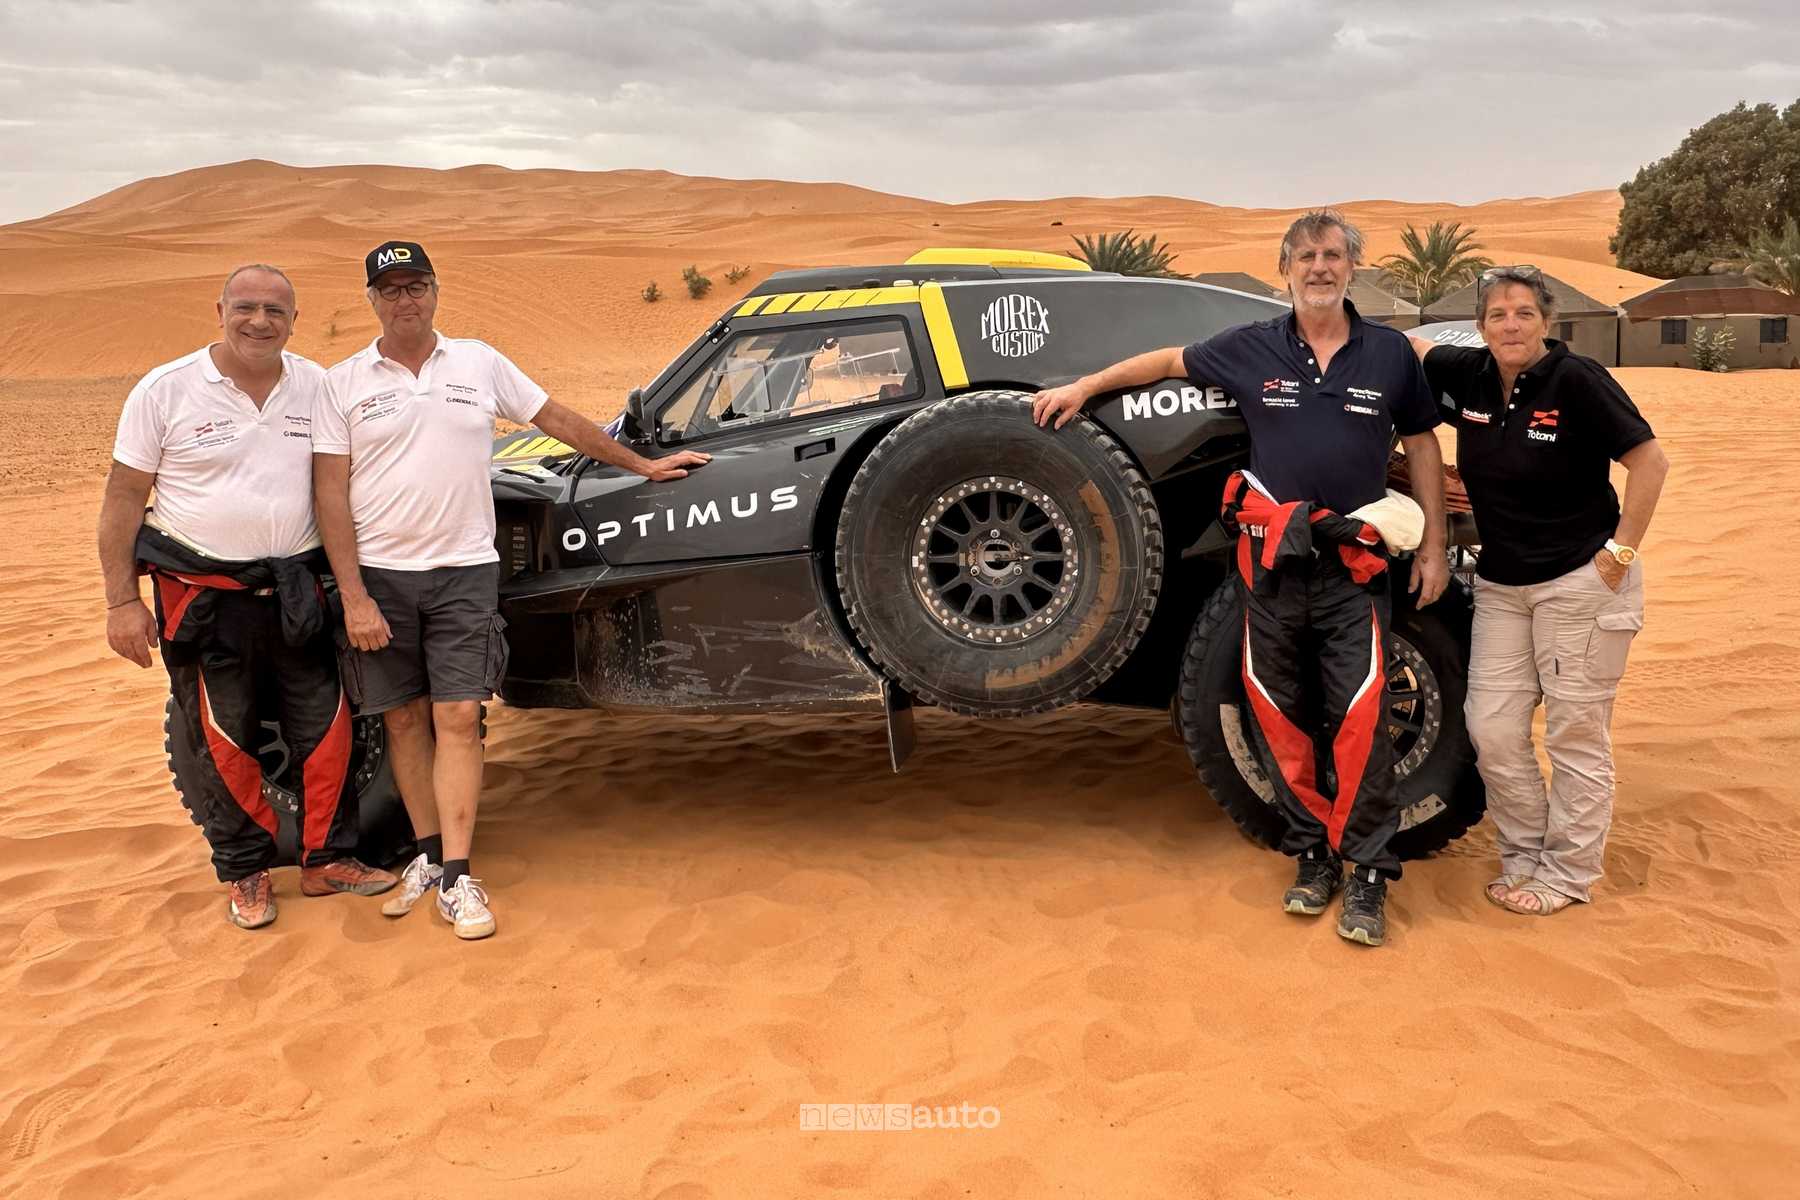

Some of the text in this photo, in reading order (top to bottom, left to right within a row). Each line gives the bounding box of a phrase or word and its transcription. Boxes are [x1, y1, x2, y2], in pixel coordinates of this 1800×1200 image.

[377, 248, 411, 267] MD
[981, 294, 1050, 340] MOREX
[992, 331, 1045, 357] CUSTOM
[1121, 386, 1238, 421] MORE
[1527, 429, 1557, 442] Totani
[562, 485, 798, 551] OPTIMUS
